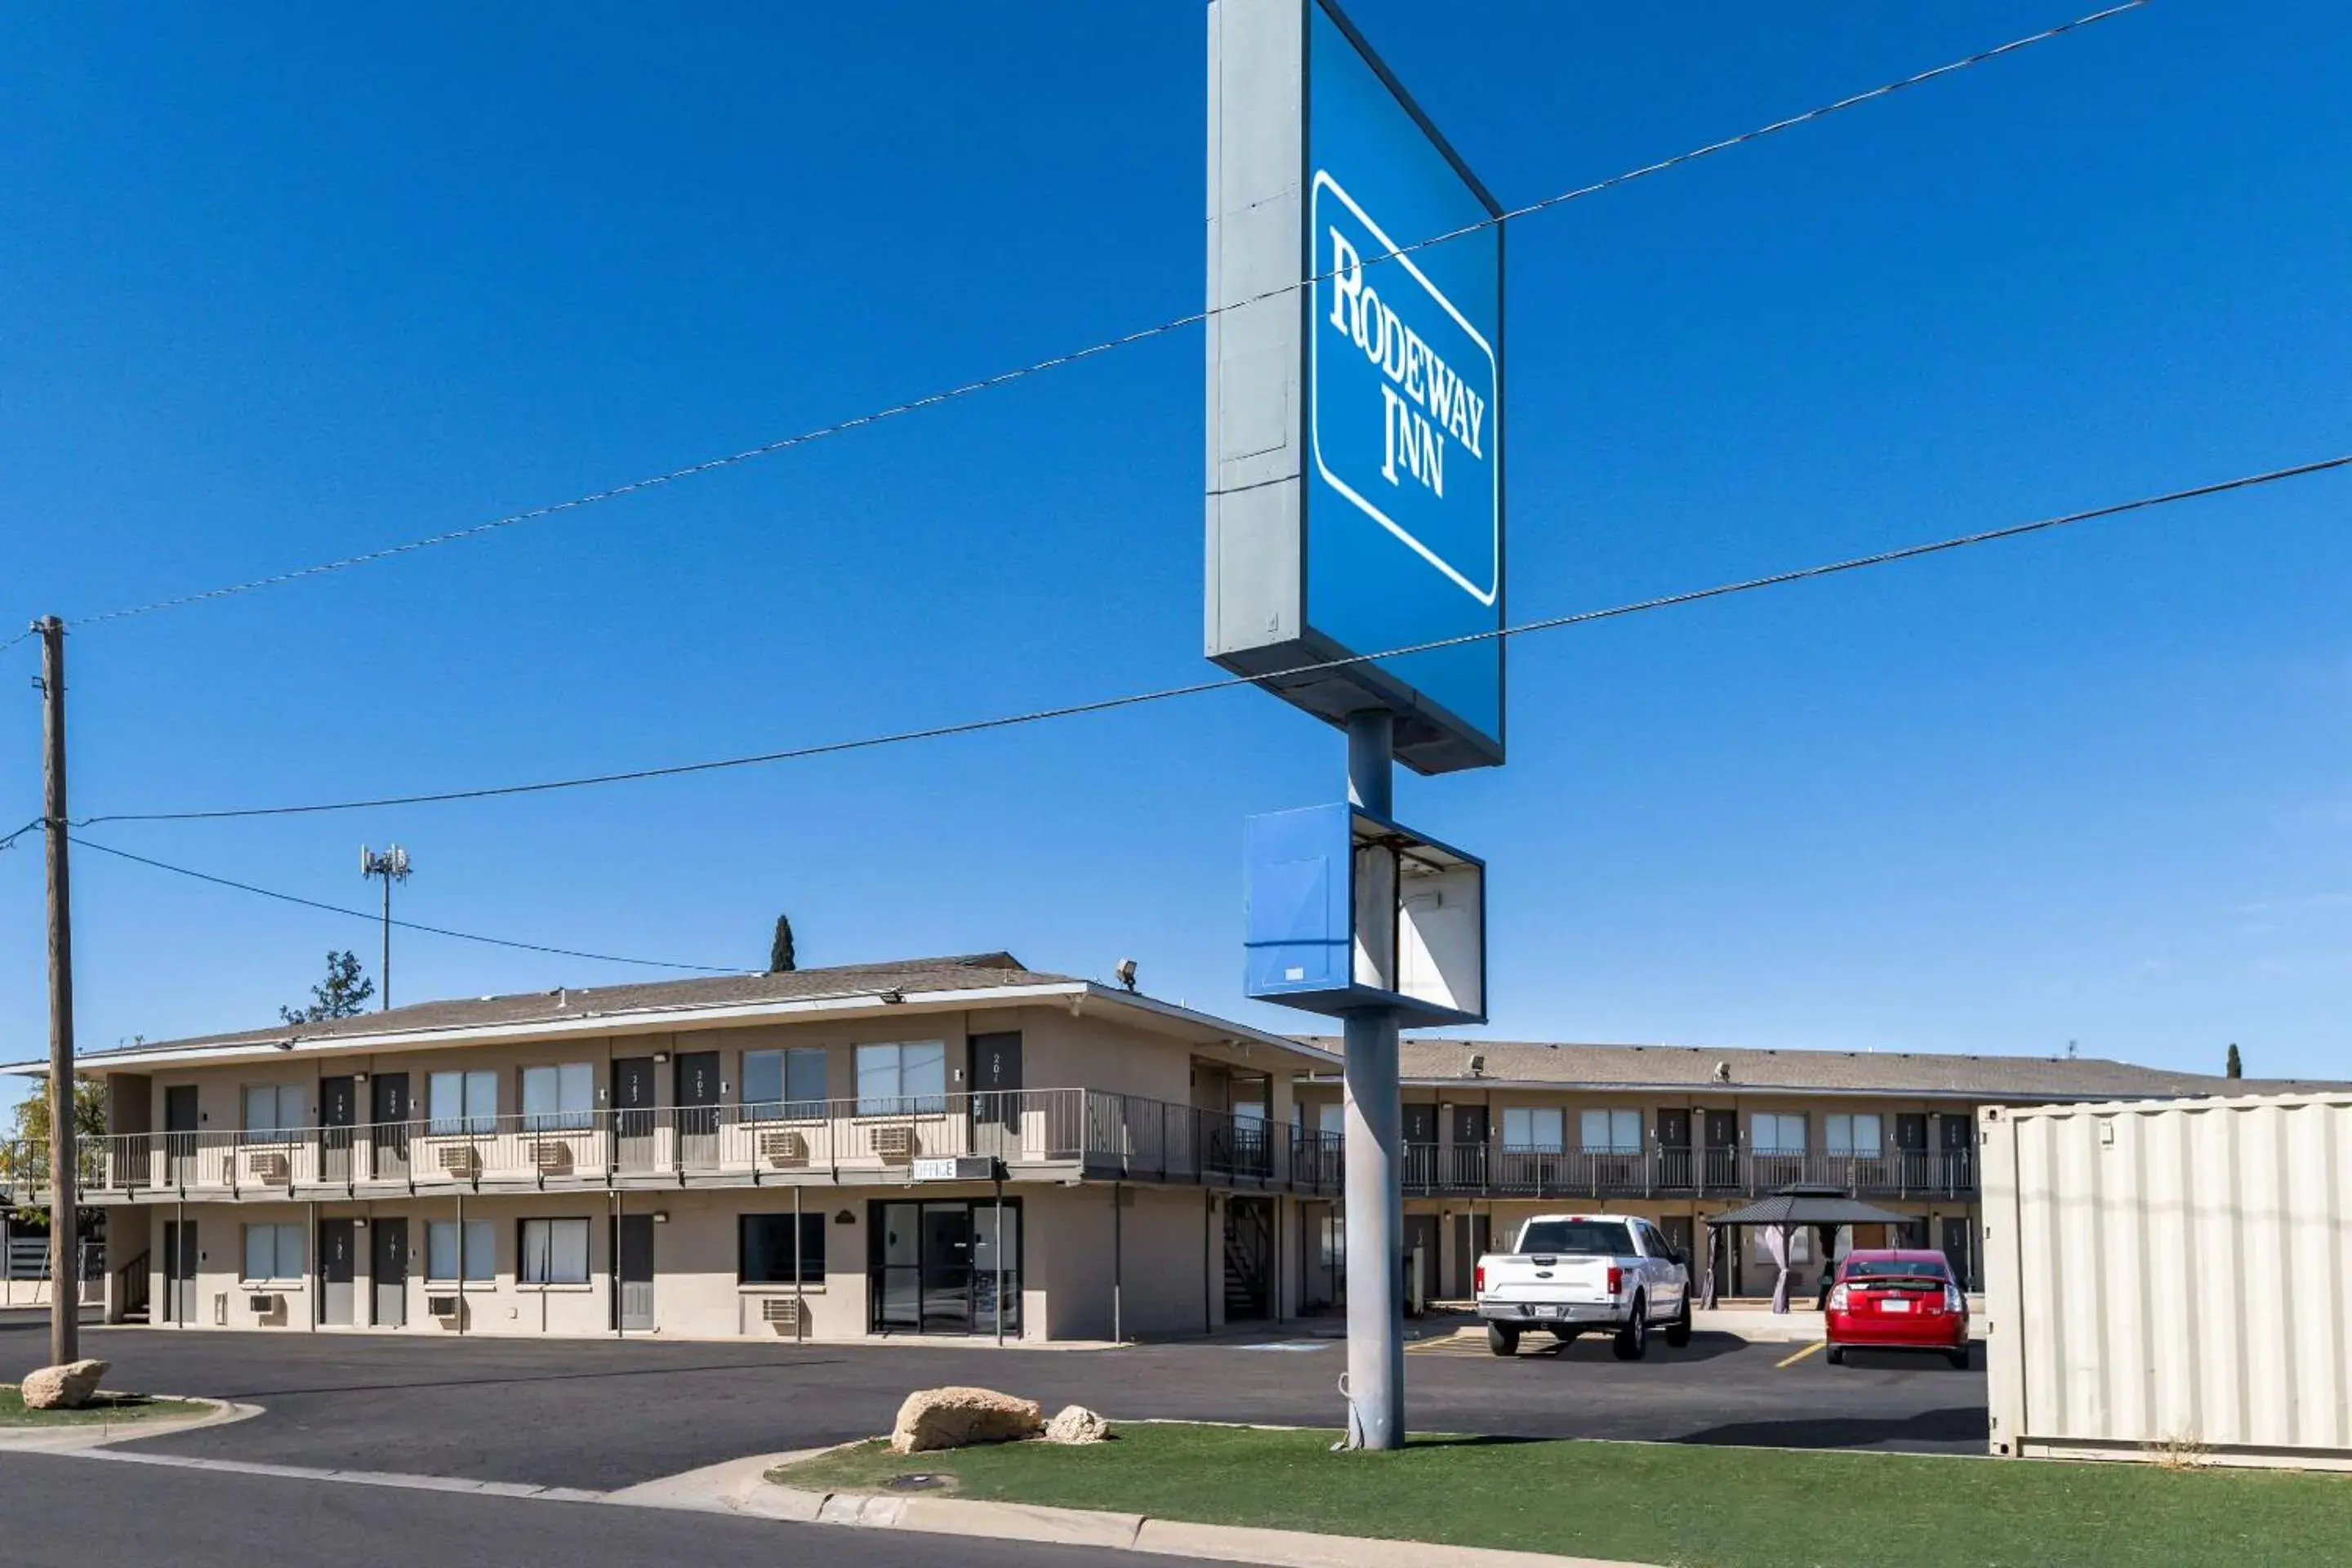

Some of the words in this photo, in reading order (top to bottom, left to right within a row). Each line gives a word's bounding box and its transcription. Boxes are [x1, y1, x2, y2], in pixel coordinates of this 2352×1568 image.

[1330, 225, 1485, 461] RODEWAY
[1380, 381, 1445, 499] INN
[915, 1161, 953, 1177] OFFICE
